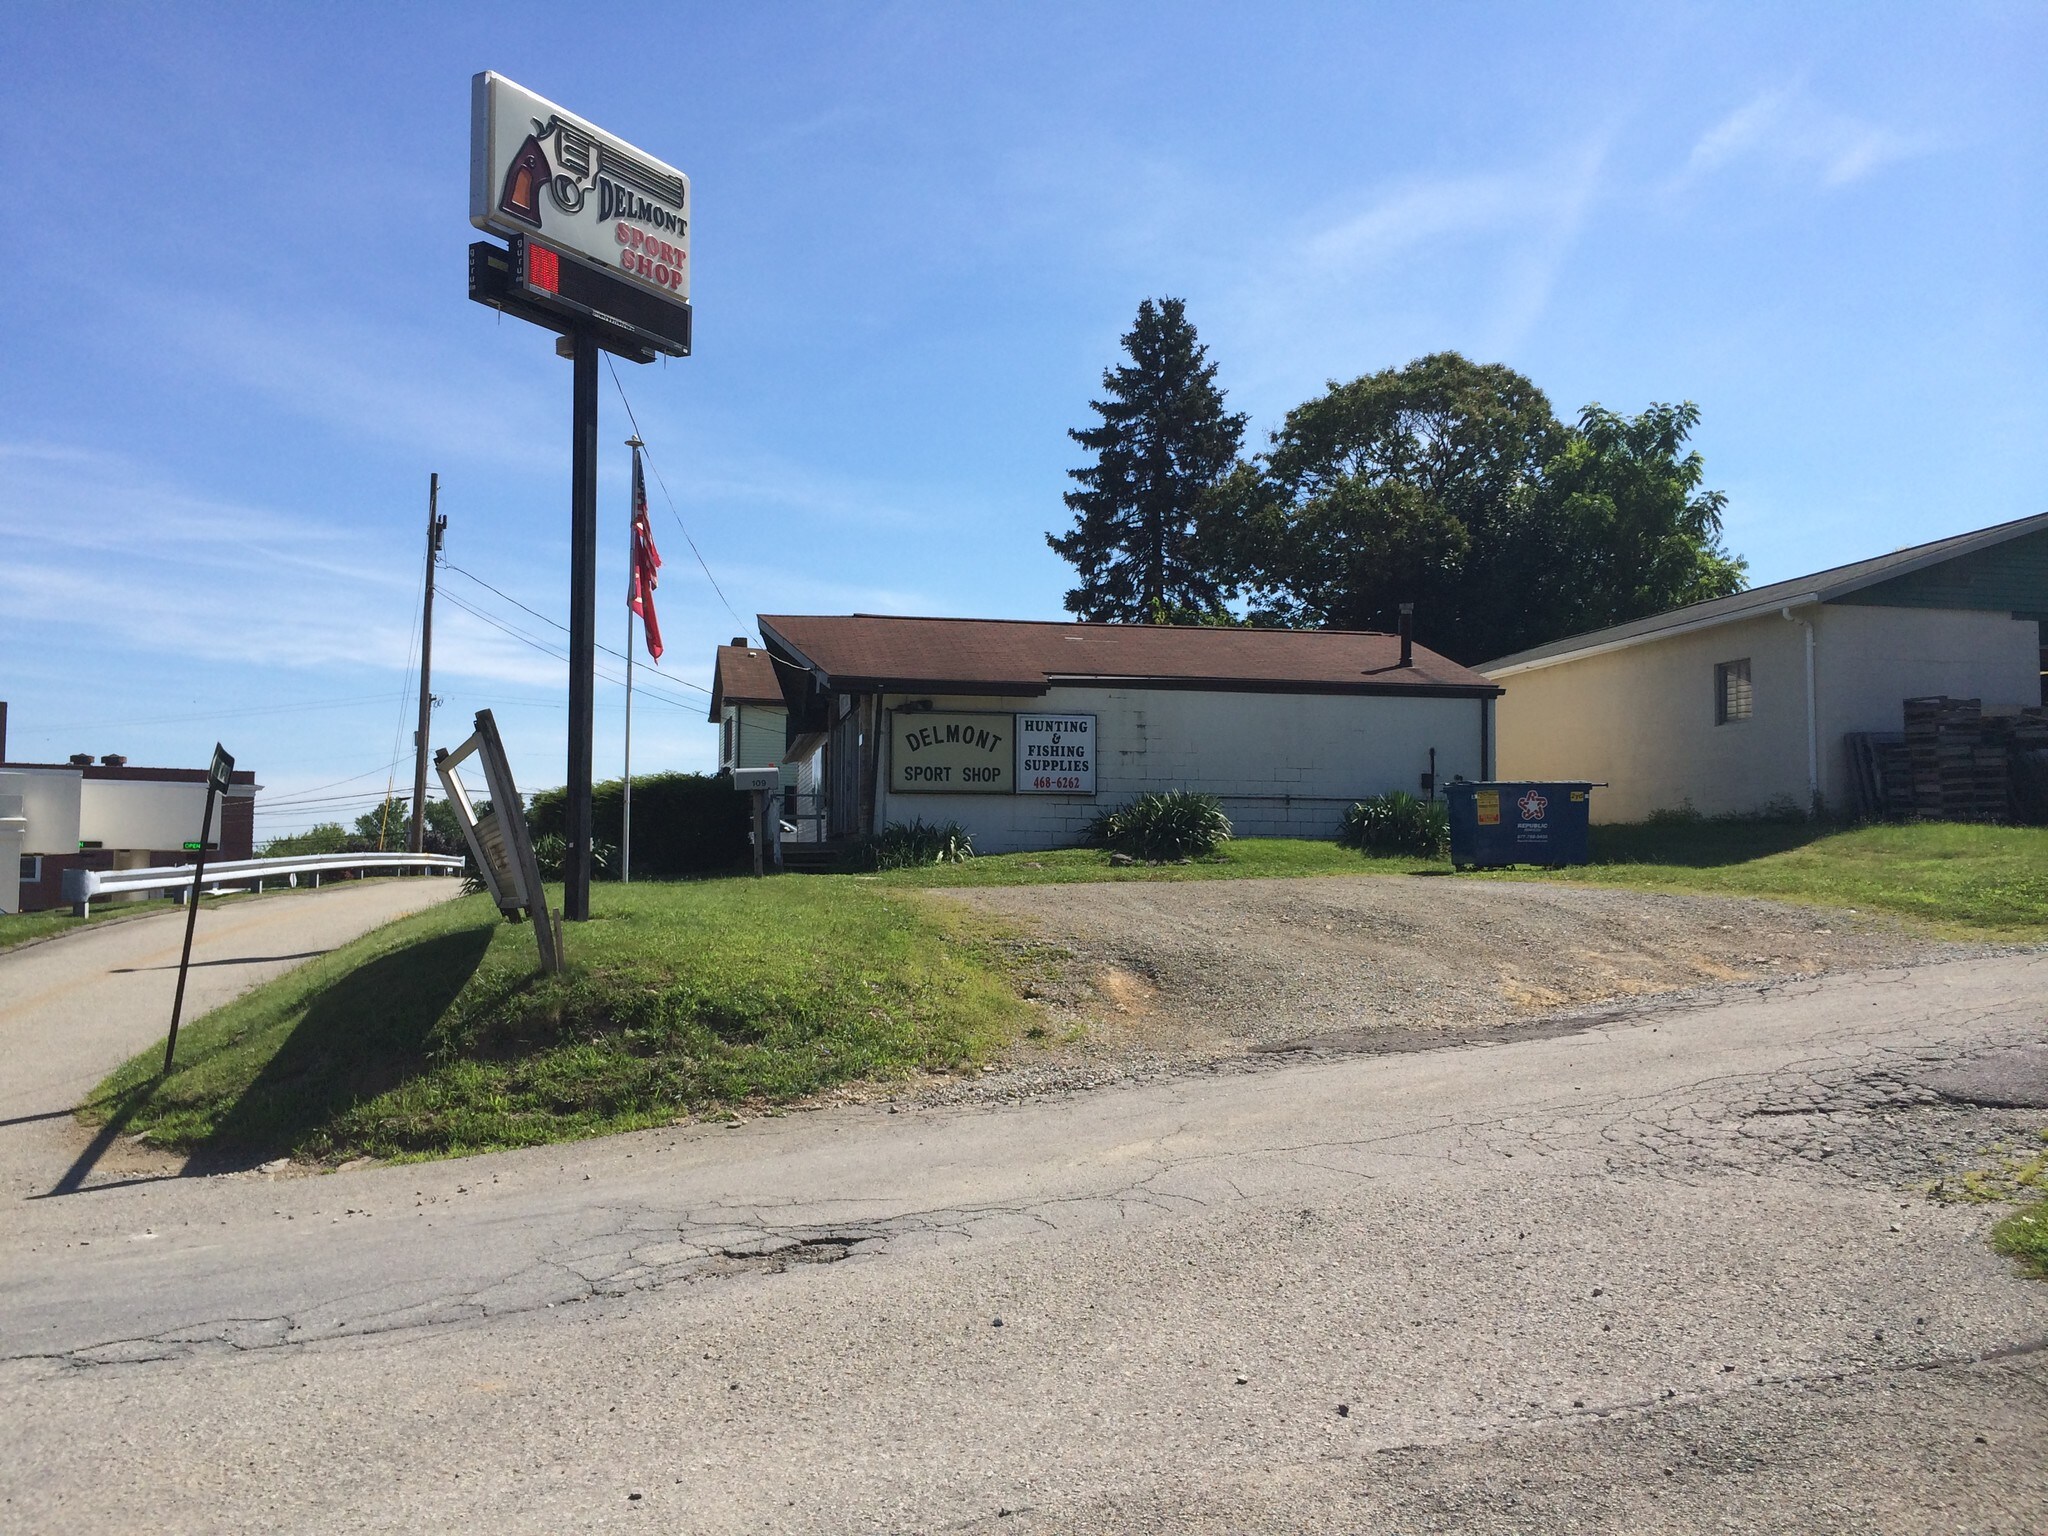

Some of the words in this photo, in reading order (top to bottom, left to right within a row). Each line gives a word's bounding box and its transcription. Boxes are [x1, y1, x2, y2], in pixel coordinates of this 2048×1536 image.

[599, 176, 688, 236] DELMONT
[616, 221, 687, 268] SPORT
[622, 248, 683, 289] SHOP
[1024, 720, 1088, 733] HUNTING
[905, 724, 1002, 753] DELMONT
[1052, 733, 1061, 744] &
[1028, 745, 1085, 757] FISHING
[1024, 759, 1089, 772] SUPPLIES
[904, 766, 952, 782] SPORT
[963, 767, 1001, 782] SHOP
[752, 779, 767, 787] 109
[1033, 777, 1080, 789] 468-6262
